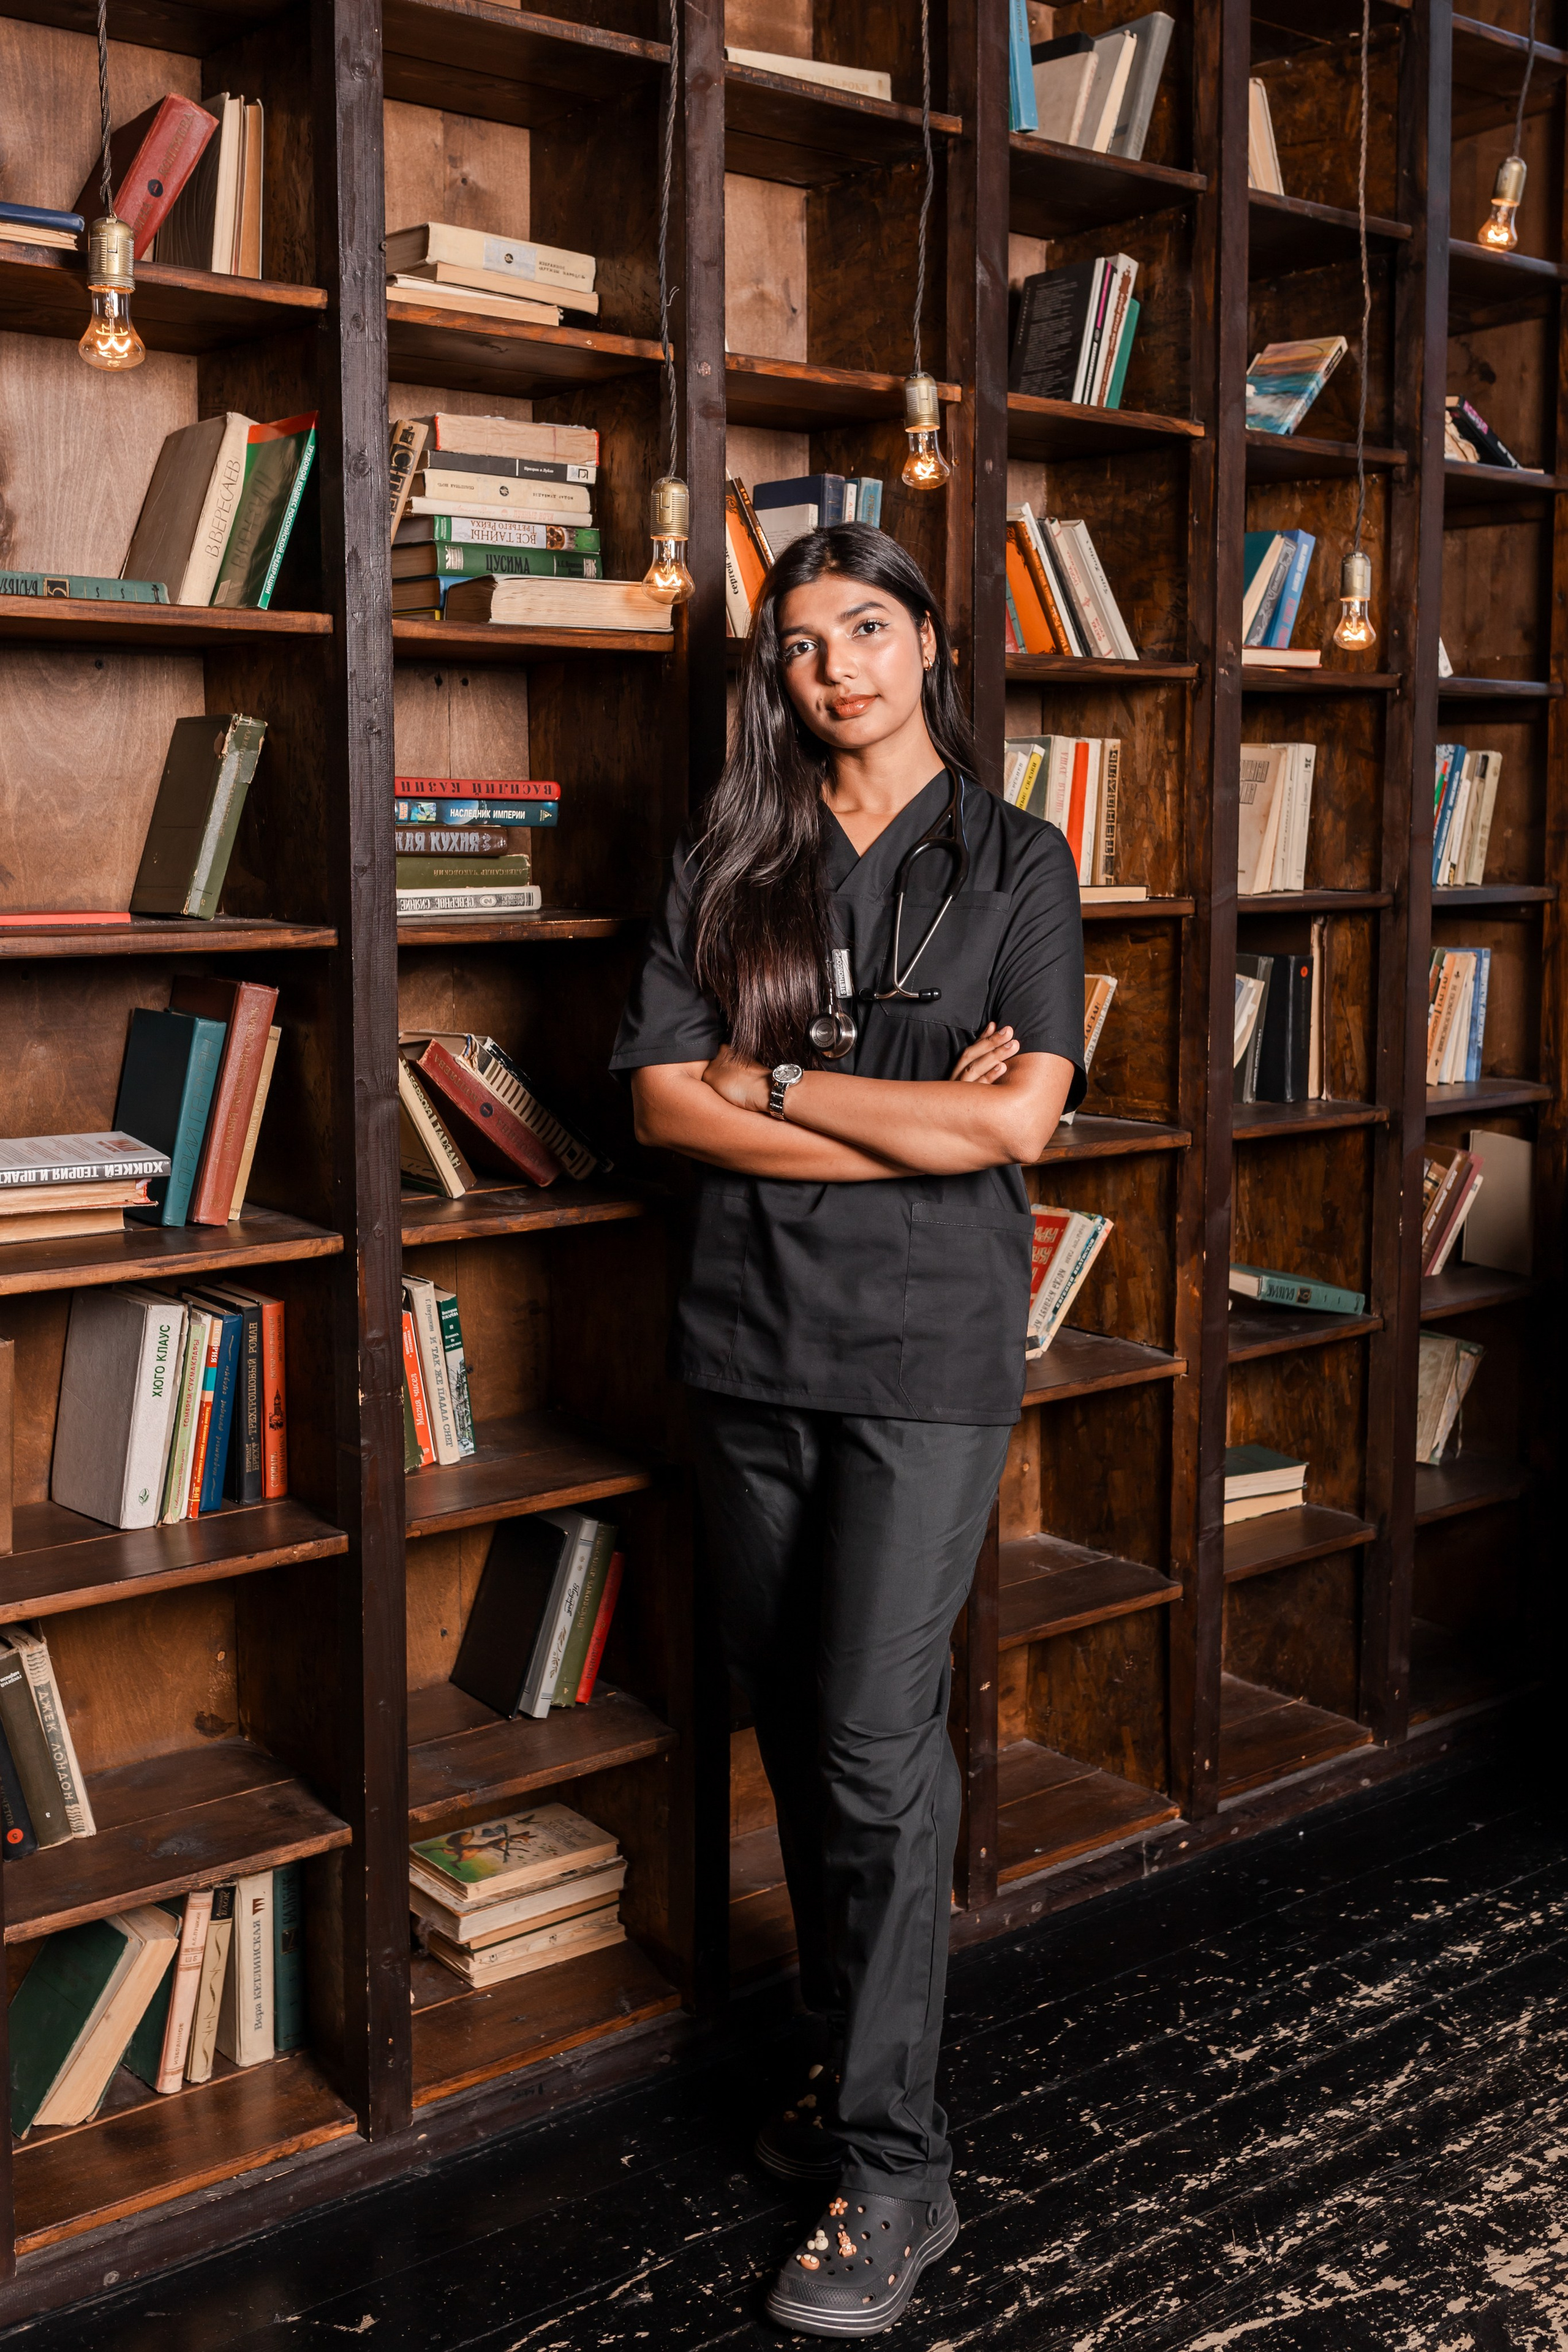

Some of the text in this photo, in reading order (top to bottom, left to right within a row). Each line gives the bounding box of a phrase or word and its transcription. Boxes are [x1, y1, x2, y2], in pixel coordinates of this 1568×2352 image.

[157, 111, 194, 178] КОПТЯЕВА
[264, 445, 315, 595] ТРУДОВОЙ КОДЕКС РОССИЙСКОЙ ФЕДЕРАЦИИ
[470, 528, 537, 545] ВСЕ ТАЙНЫ
[486, 554, 530, 574] ЦУСИМА
[48, 582, 68, 597] 5
[401, 781, 552, 795] ВАСИЛИЙ КАЗИН
[450, 808, 526, 819] НАСЛЕДНИК ИМПЕРИИ
[1103, 749, 1118, 875] ТЕНДАЛЬ
[430, 832, 480, 852] КУХНЯ
[400, 899, 475, 910] СЕВЕРНОЕ СИЯНИЕ
[836, 952, 847, 995] STETHOSCOPE
[224, 1006, 260, 1152] МАЛЫЙ ТОЛКОВЫЙ СЛОВАРЬ
[434, 1054, 478, 1104] КОПТЯЕВА
[246, 1074, 269, 1151] ГАЛИНА ВОСТОКОВА
[40, 1168, 48, 1181] И
[52, 1165, 98, 1180] ТЕОРИЯ
[105, 1161, 163, 1178] ХОККЕЙ
[1055, 1275, 1074, 1309] ЕВГЕНИЙ
[1266, 1283, 1295, 1302] БАЛЬЗАК
[425, 1307, 434, 1332] Паушкин
[211, 1325, 221, 1363] ИСТОРИЯ
[430, 1336, 436, 1344] И
[152, 1324, 170, 1398] ХЮГО КЛАУС
[247, 1322, 257, 1435] ТРЕХГРОШОВЫЙ РОМАН
[434, 1368, 443, 1385] ЖЕ
[183, 1338, 200, 1428] ГОМЕРЕМ СУКМАКЛАРЫ
[412, 1373, 425, 1427] Магия чисел
[438, 1388, 448, 1422] ПАДАЛ
[443, 1423, 453, 1447] СНЕГ
[564, 1582, 580, 1618] Подарок
[577, 1579, 595, 1628] ЧАКОВСКИЙ
[37, 1691, 74, 1801] ДЖЕК ЛОНДОН
[191, 1912, 202, 1947] А.С.ПУШКИН
[253, 1919, 263, 2031] Вера КЕТЛИНСКАЯ
[173, 2022, 184, 2065] ИЗБРАННОЕ
